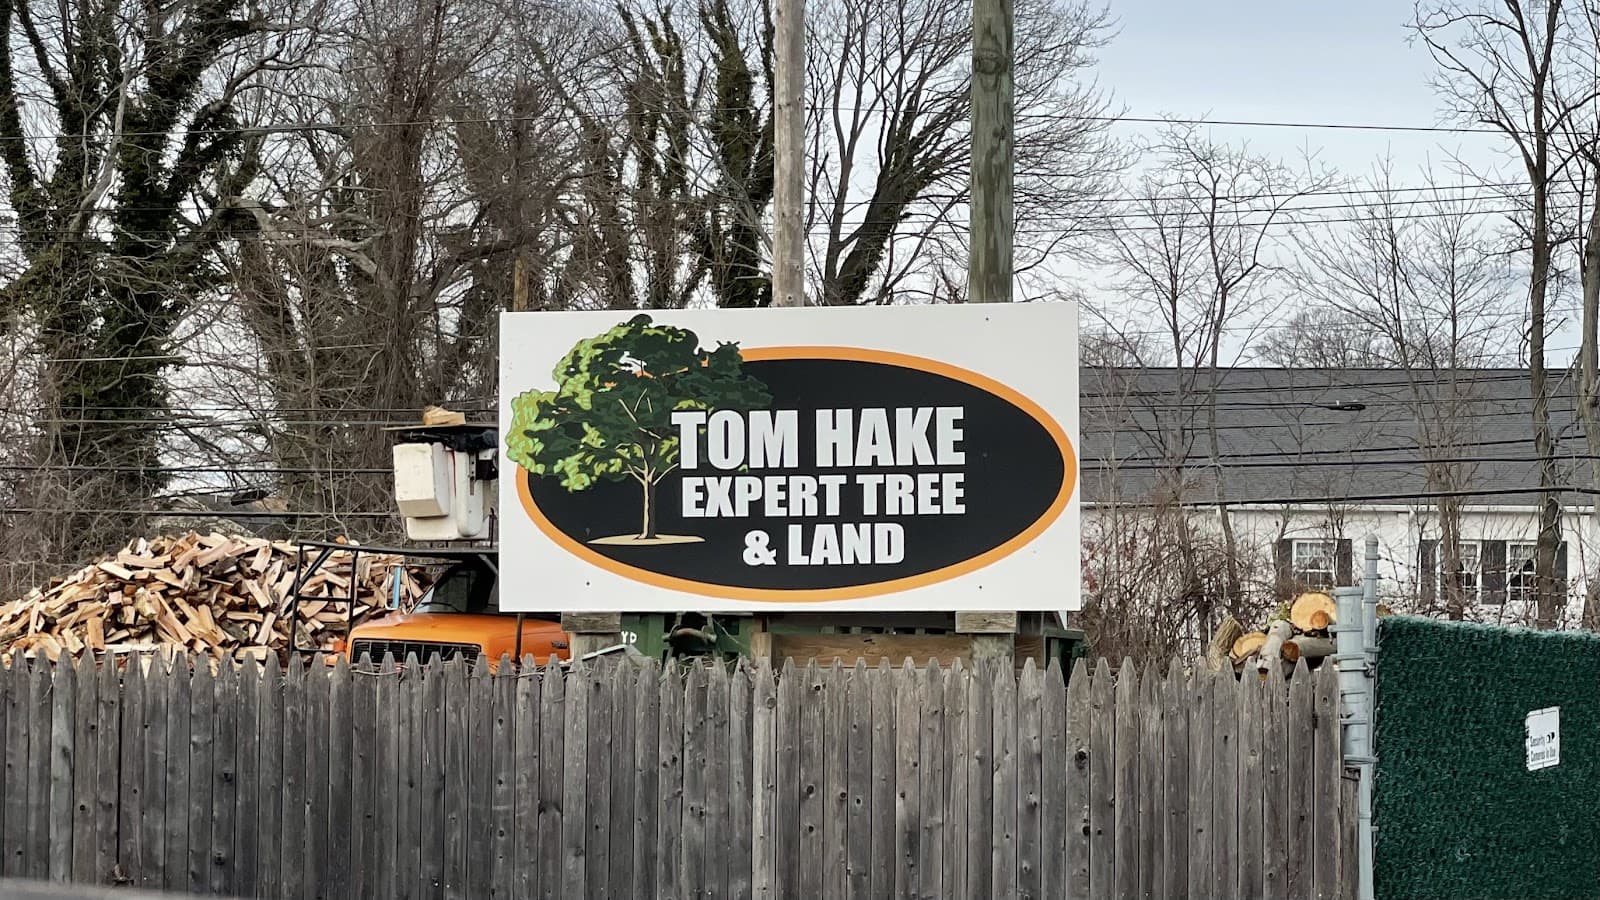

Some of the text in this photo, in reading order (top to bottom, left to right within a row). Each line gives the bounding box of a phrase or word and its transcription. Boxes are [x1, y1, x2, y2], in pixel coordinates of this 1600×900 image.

[671, 406, 966, 470] TOM HAKE
[682, 472, 966, 518] EXPERT TREE
[742, 523, 905, 567] & LAND
[1530, 735, 1546, 747] Security
